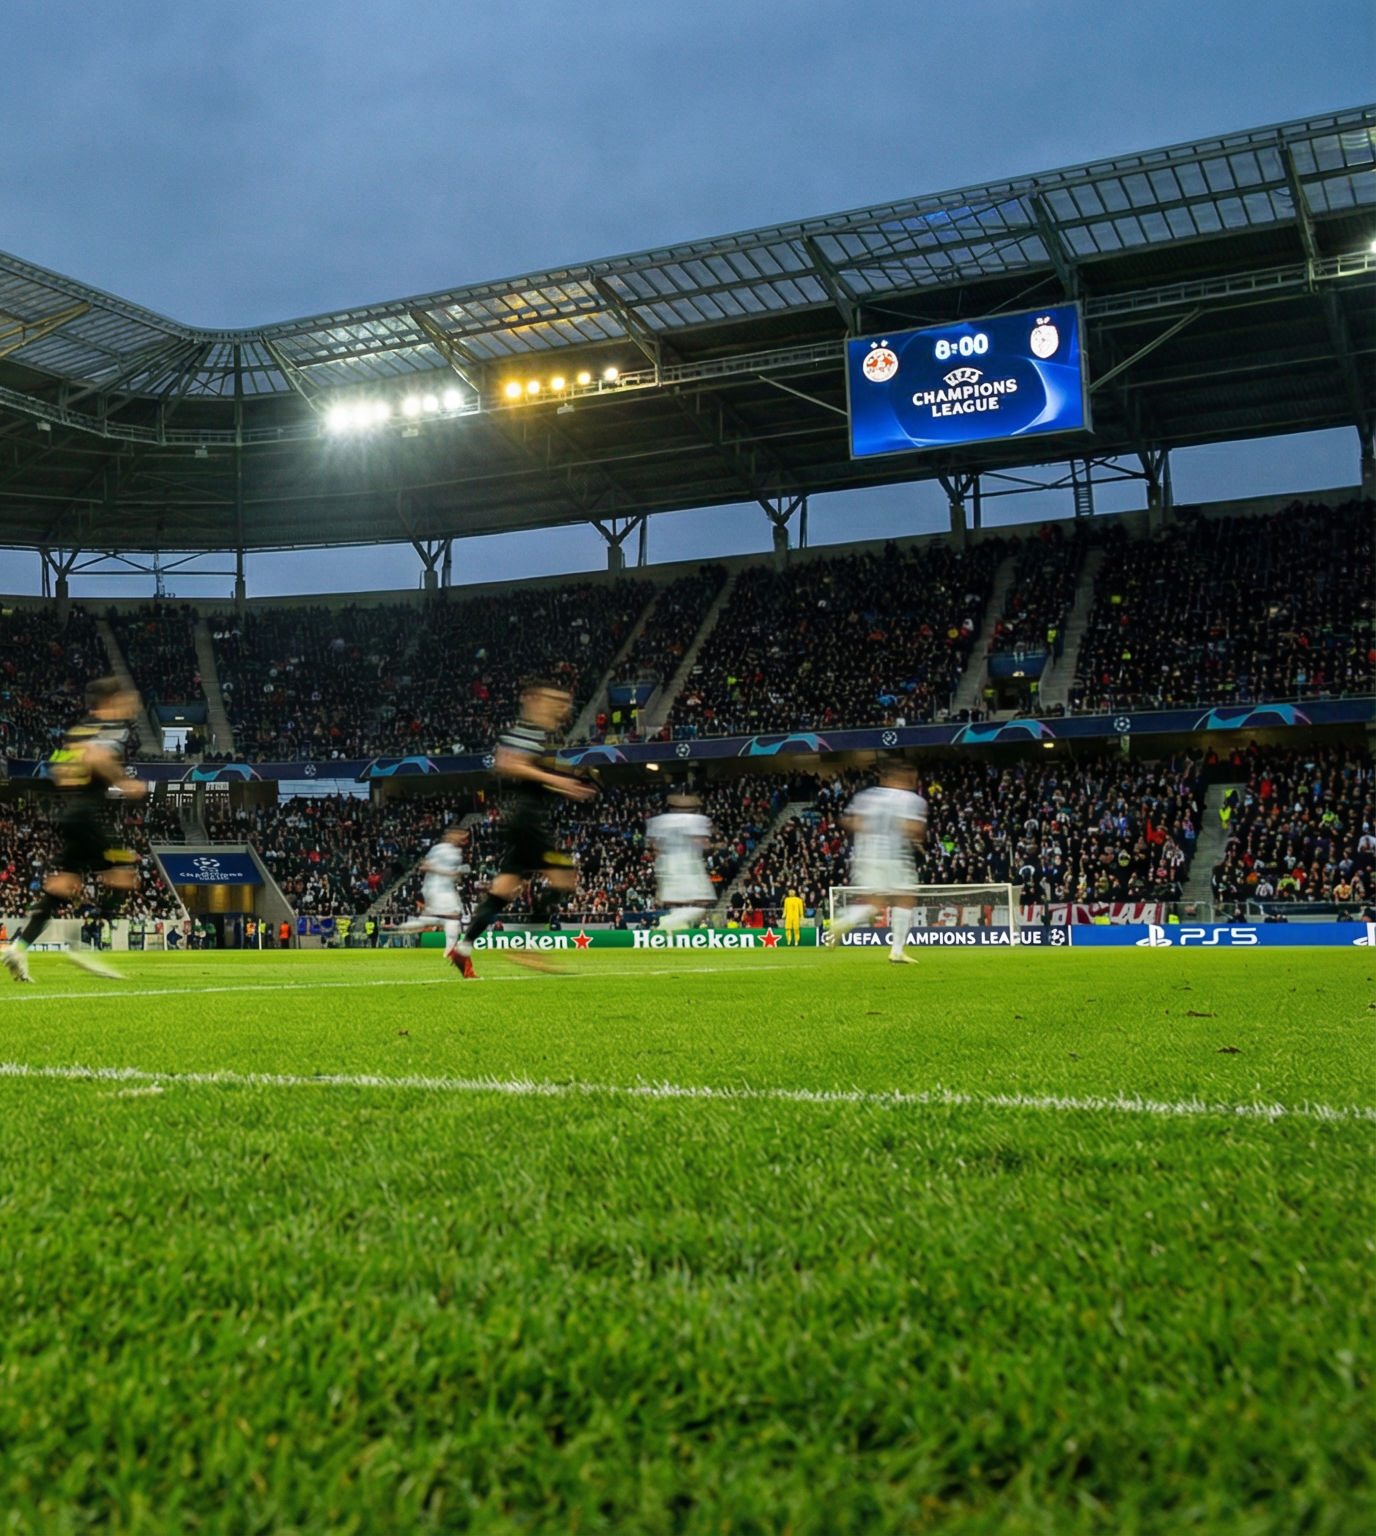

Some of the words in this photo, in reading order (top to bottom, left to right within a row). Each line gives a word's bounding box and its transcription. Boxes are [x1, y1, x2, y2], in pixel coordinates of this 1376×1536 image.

[935, 334, 988, 360] 8:00
[912, 379, 1017, 406] CHAMPIONS
[932, 397, 999, 417] LEAGUE
[473, 931, 568, 950] eineken
[632, 929, 755, 949] Heineken
[842, 932, 882, 945] UEFA
[885, 932, 976, 945] CAMPIONS
[1180, 927, 1258, 945] PS5
